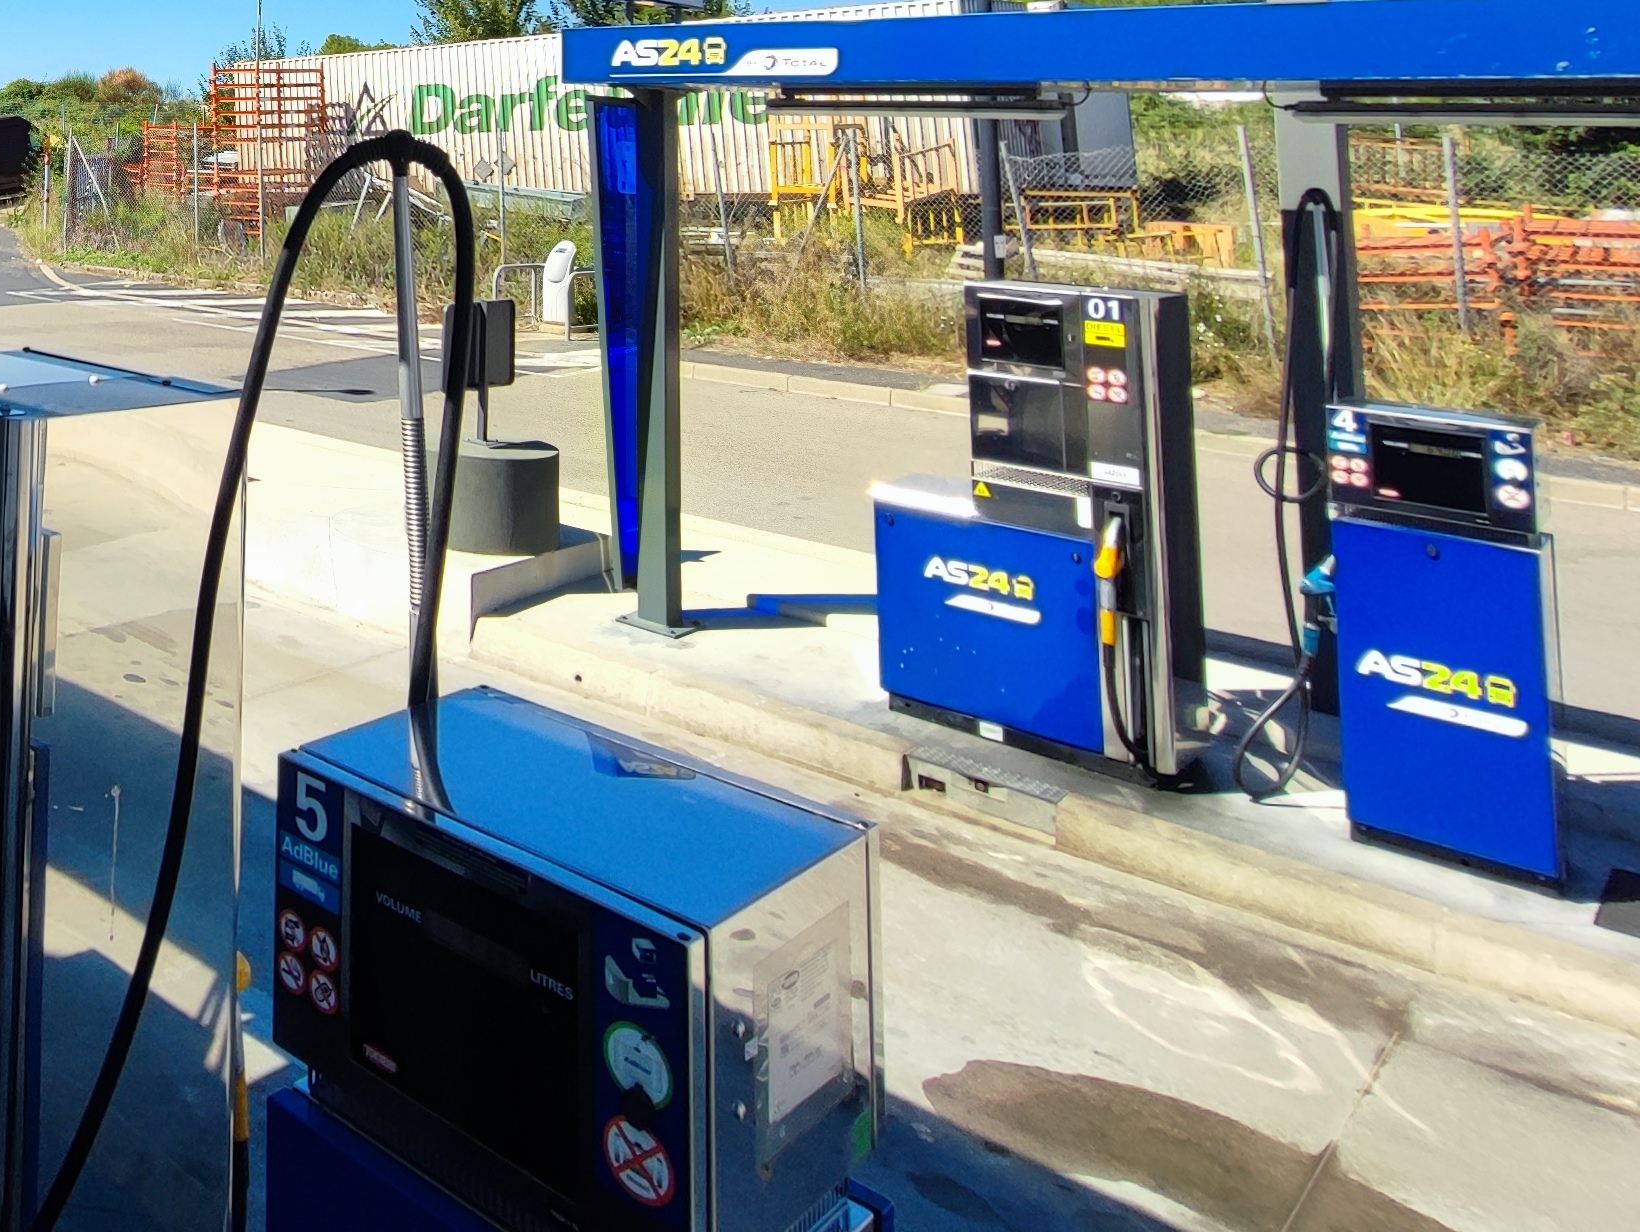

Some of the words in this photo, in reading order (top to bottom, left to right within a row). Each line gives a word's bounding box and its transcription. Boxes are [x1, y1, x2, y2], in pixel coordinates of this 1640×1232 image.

[611, 38, 702, 67] AS24
[1088, 298, 1119, 320] 01
[1332, 410, 1358, 432] 4
[924, 556, 1010, 595] AS24
[1358, 649, 1482, 700] AS24
[295, 771, 328, 842] 5
[281, 836, 339, 879] AdBlue
[375, 890, 423, 924] VOLUME
[529, 967, 574, 1000] LITRES
